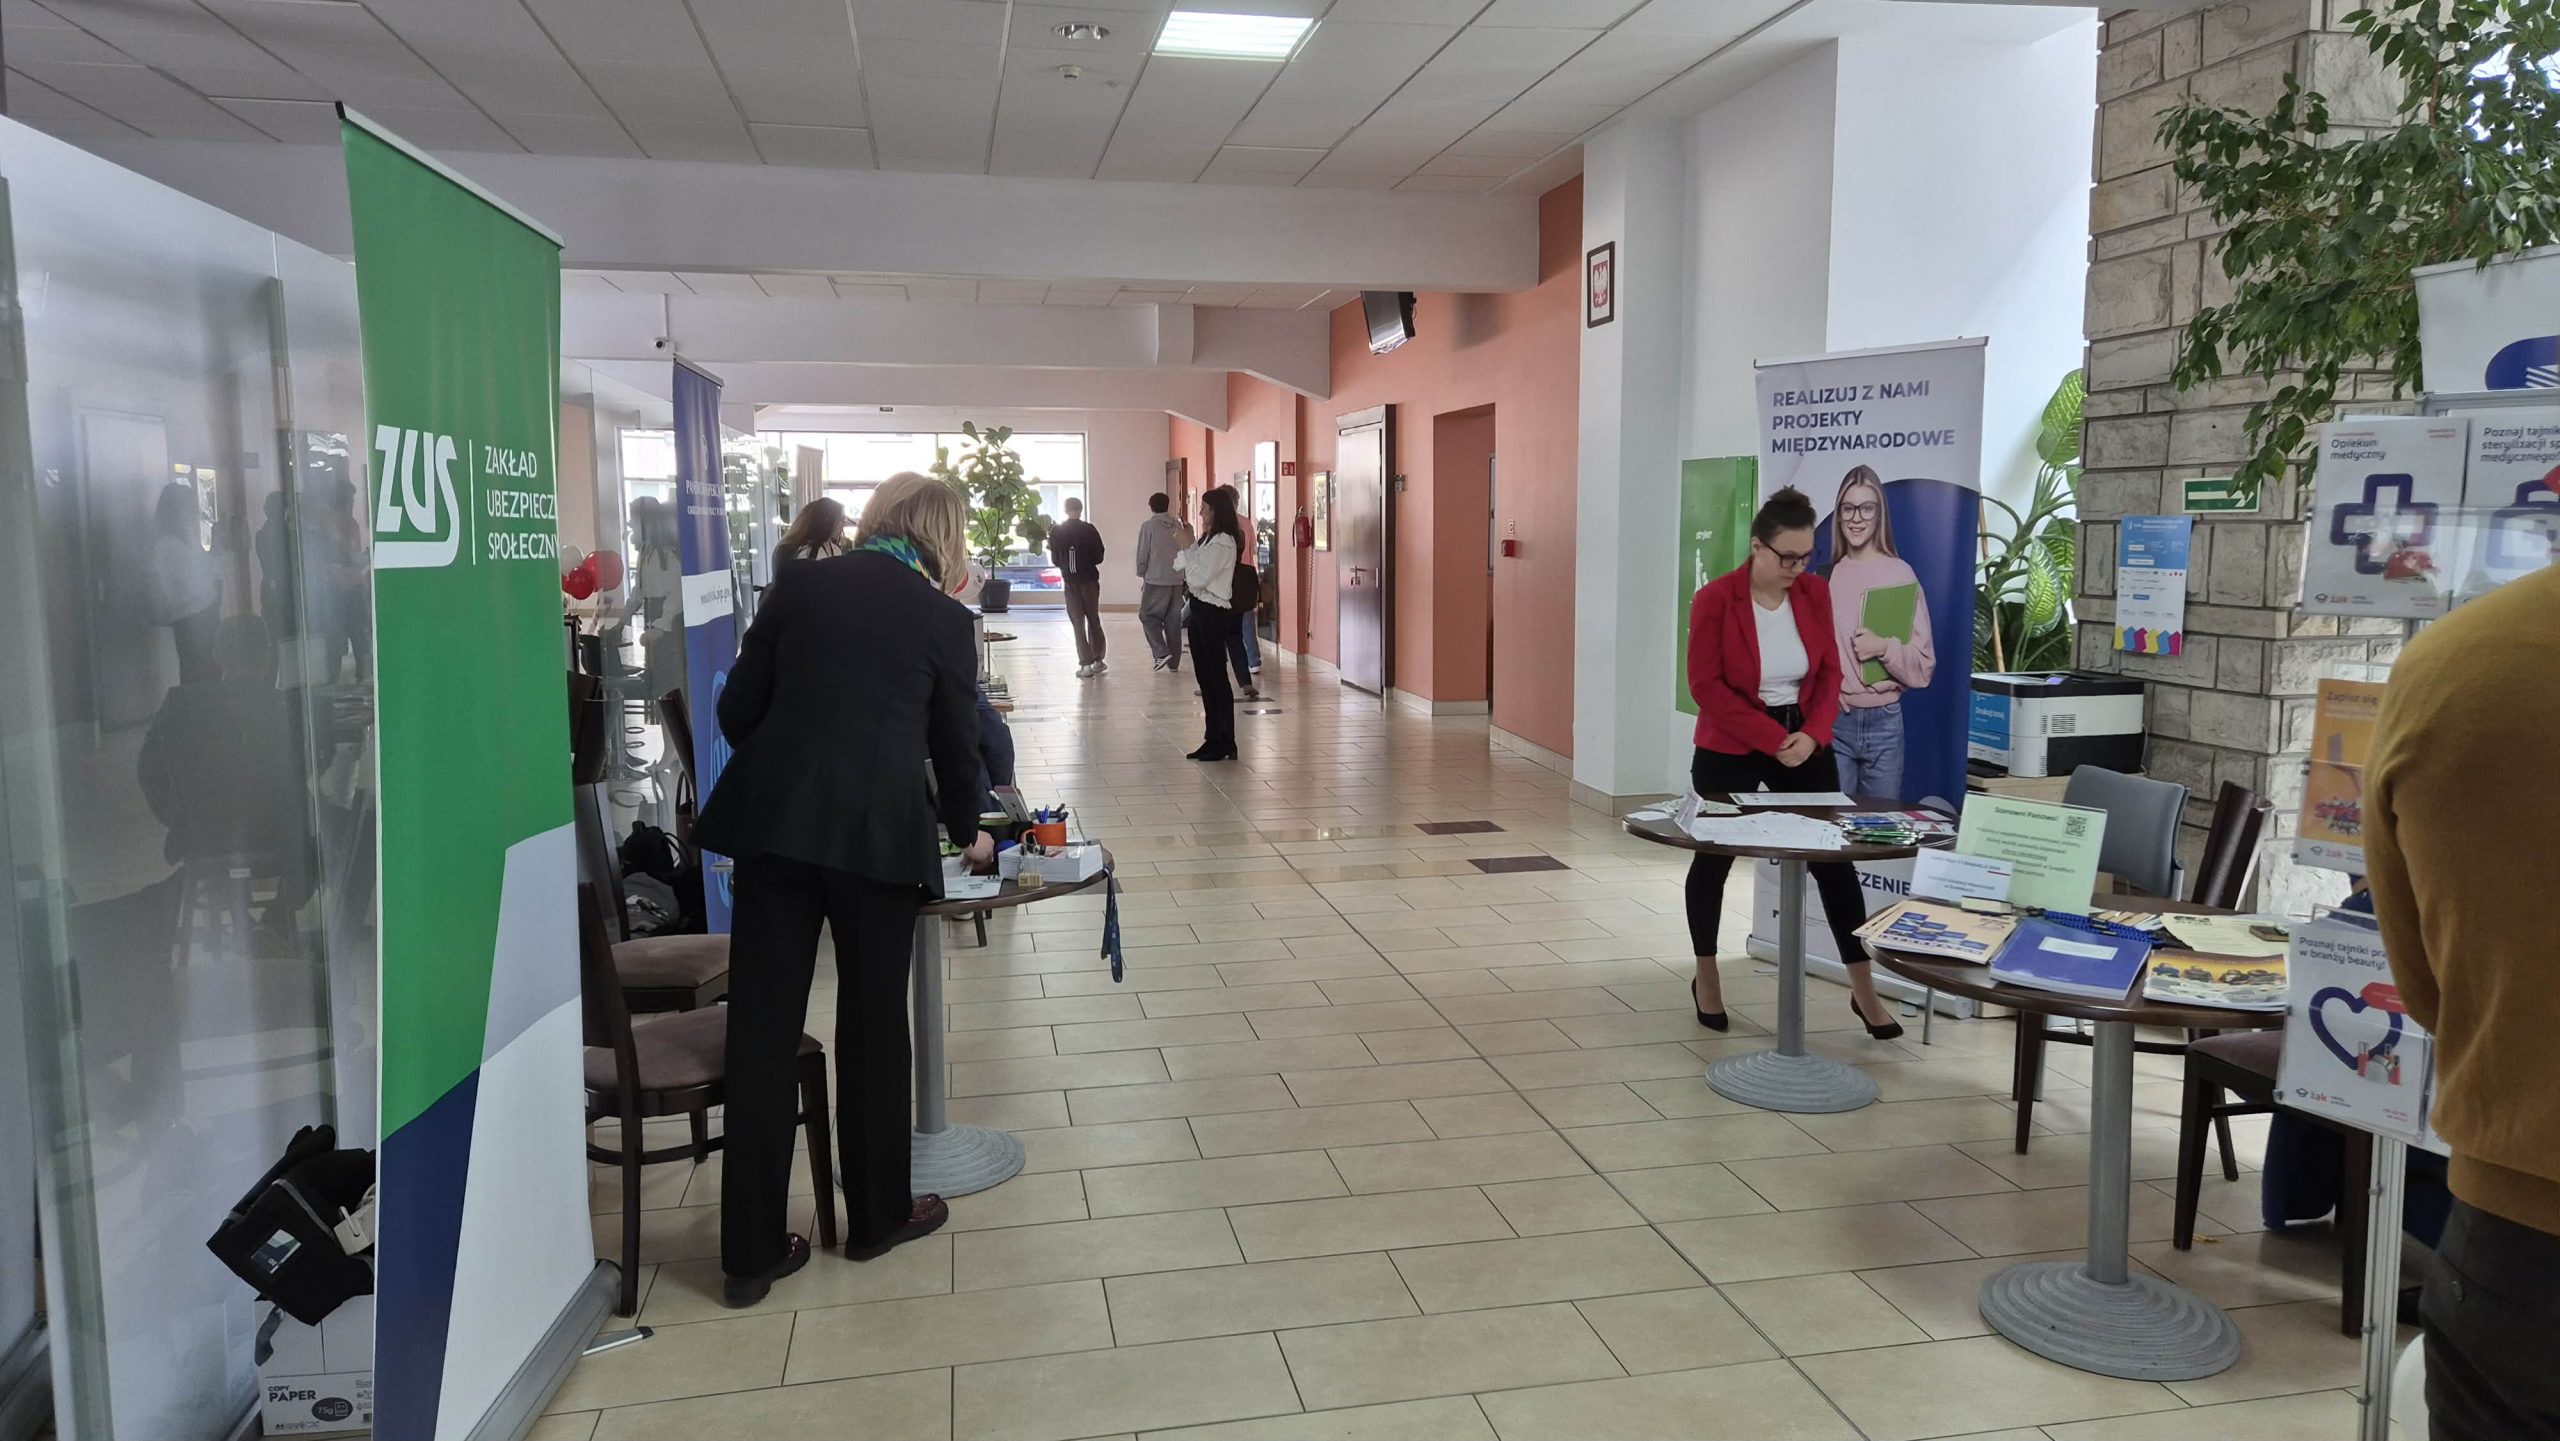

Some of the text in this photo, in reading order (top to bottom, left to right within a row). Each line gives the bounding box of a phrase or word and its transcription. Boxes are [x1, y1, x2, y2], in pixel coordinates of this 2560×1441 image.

[1773, 380, 1930, 407] REALIZUJ Z NAMI
[1772, 410, 1863, 430] PROJEKTY
[2483, 426, 2523, 438] Poznaj
[1772, 429, 1955, 457] MIĘDZYNARODOWE
[2331, 439, 2377, 450] Opiekun
[484, 445, 538, 478] ZAKŁAD
[2330, 450, 2386, 461] medyczny
[374, 424, 460, 569] ZUS
[1856, 871, 1911, 896] ZENIE
[2299, 937, 2335, 952] Poznaj
[2337, 943, 2369, 955] tajniki
[2310, 949, 2345, 965] branży
[269, 1390, 316, 1403] PAPER
